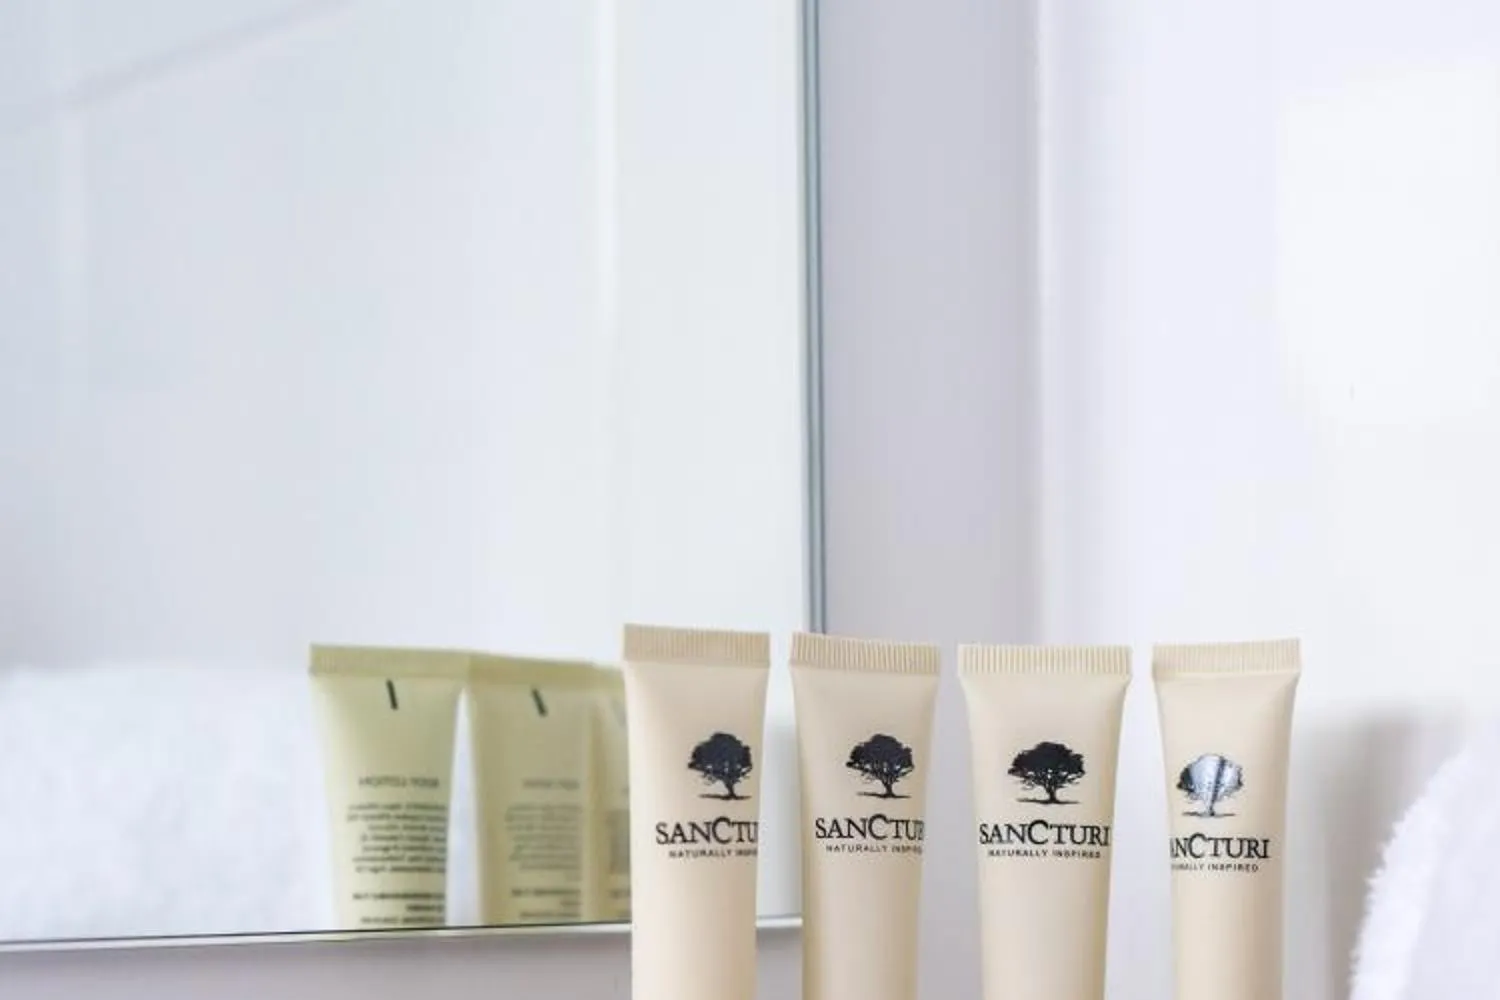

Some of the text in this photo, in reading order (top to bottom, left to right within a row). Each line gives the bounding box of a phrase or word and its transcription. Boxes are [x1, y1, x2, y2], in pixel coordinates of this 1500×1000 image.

[978, 819, 1110, 847] SANCTURI
[668, 847, 731, 859] NATURALLY
[825, 844, 887, 853] NATURALLY
[988, 849, 1101, 859] NATURALLY INSPIRED
[1207, 863, 1259, 873] INSPIRED
